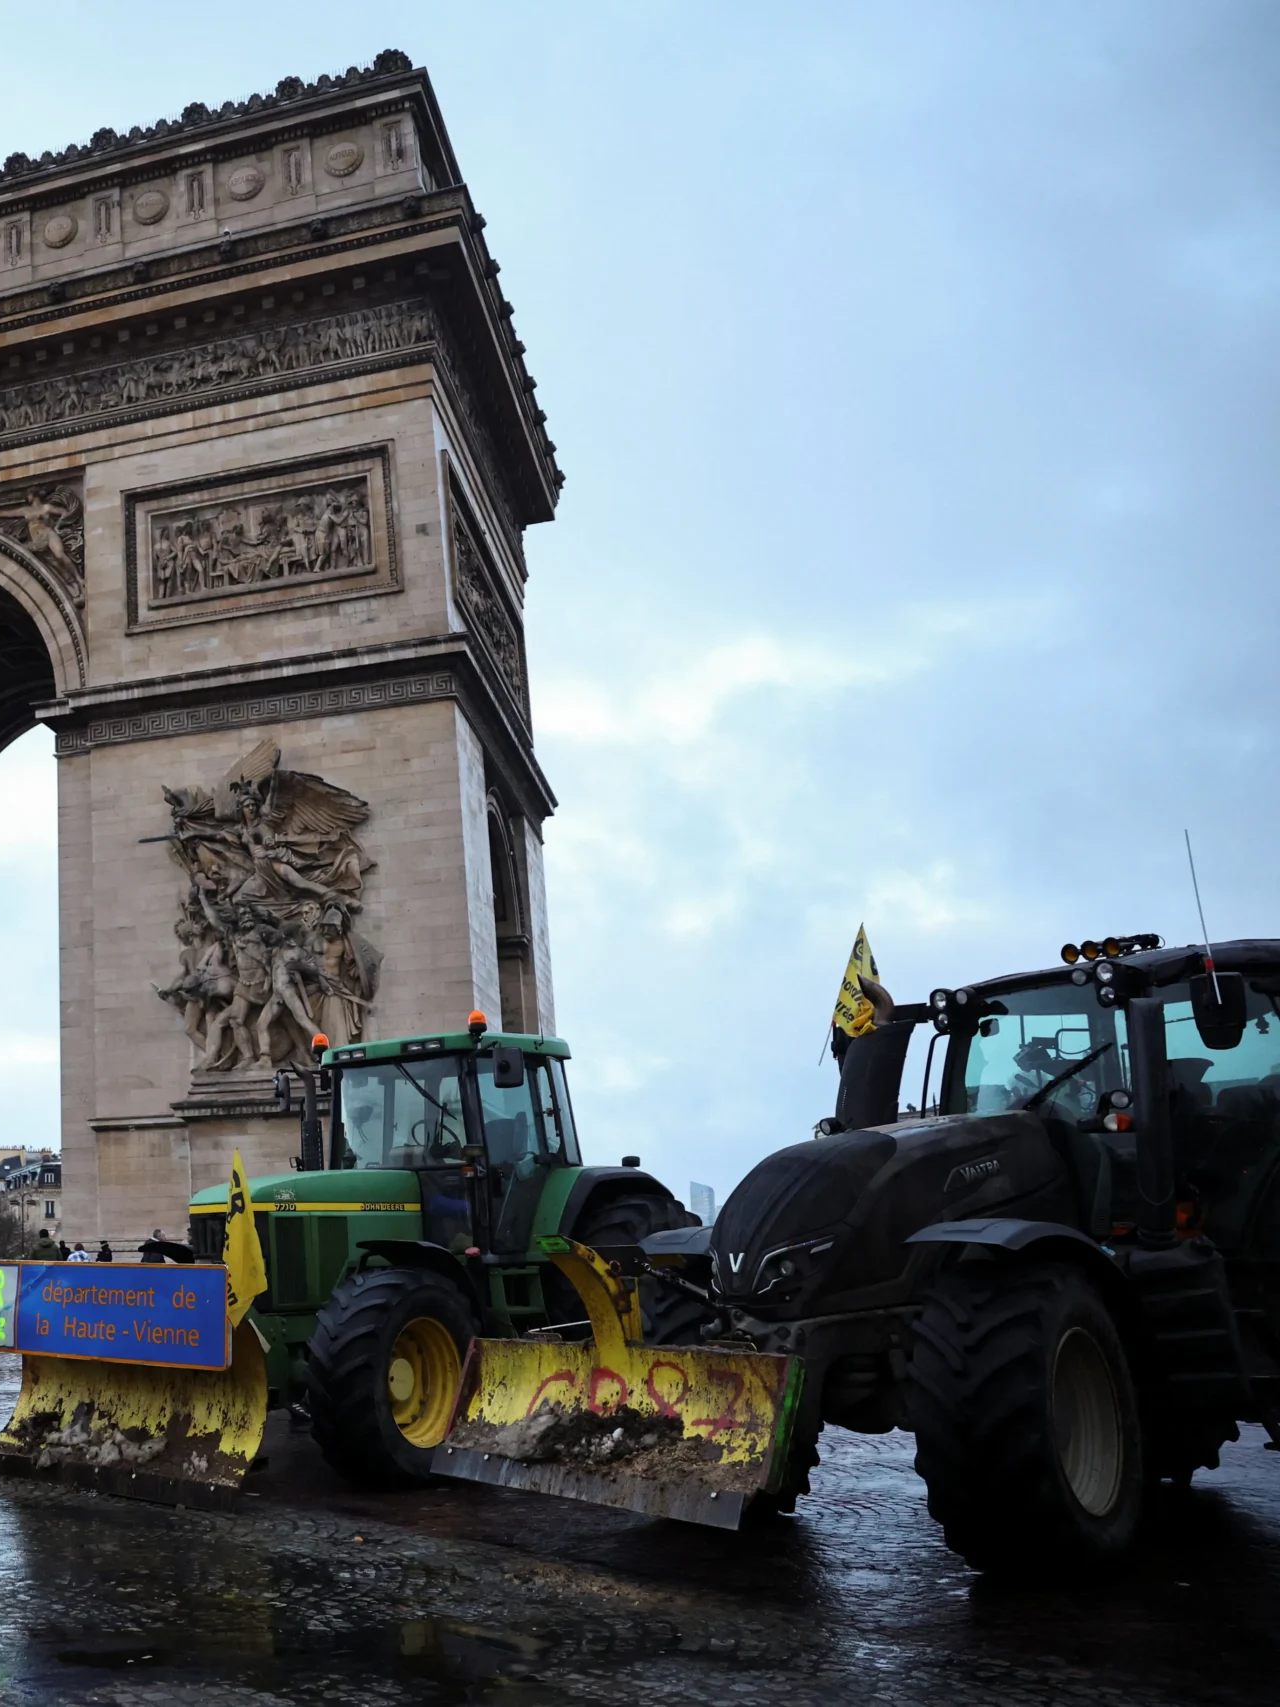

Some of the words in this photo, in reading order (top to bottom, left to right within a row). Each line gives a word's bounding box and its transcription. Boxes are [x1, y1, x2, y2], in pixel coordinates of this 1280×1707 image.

[275, 1202, 296, 1211] 7710
[361, 1202, 381, 1211] JOHN
[381, 1202, 404, 1211] DEERE
[42, 1279, 156, 1309] département
[172, 1284, 197, 1309] de
[36, 1312, 50, 1336] la
